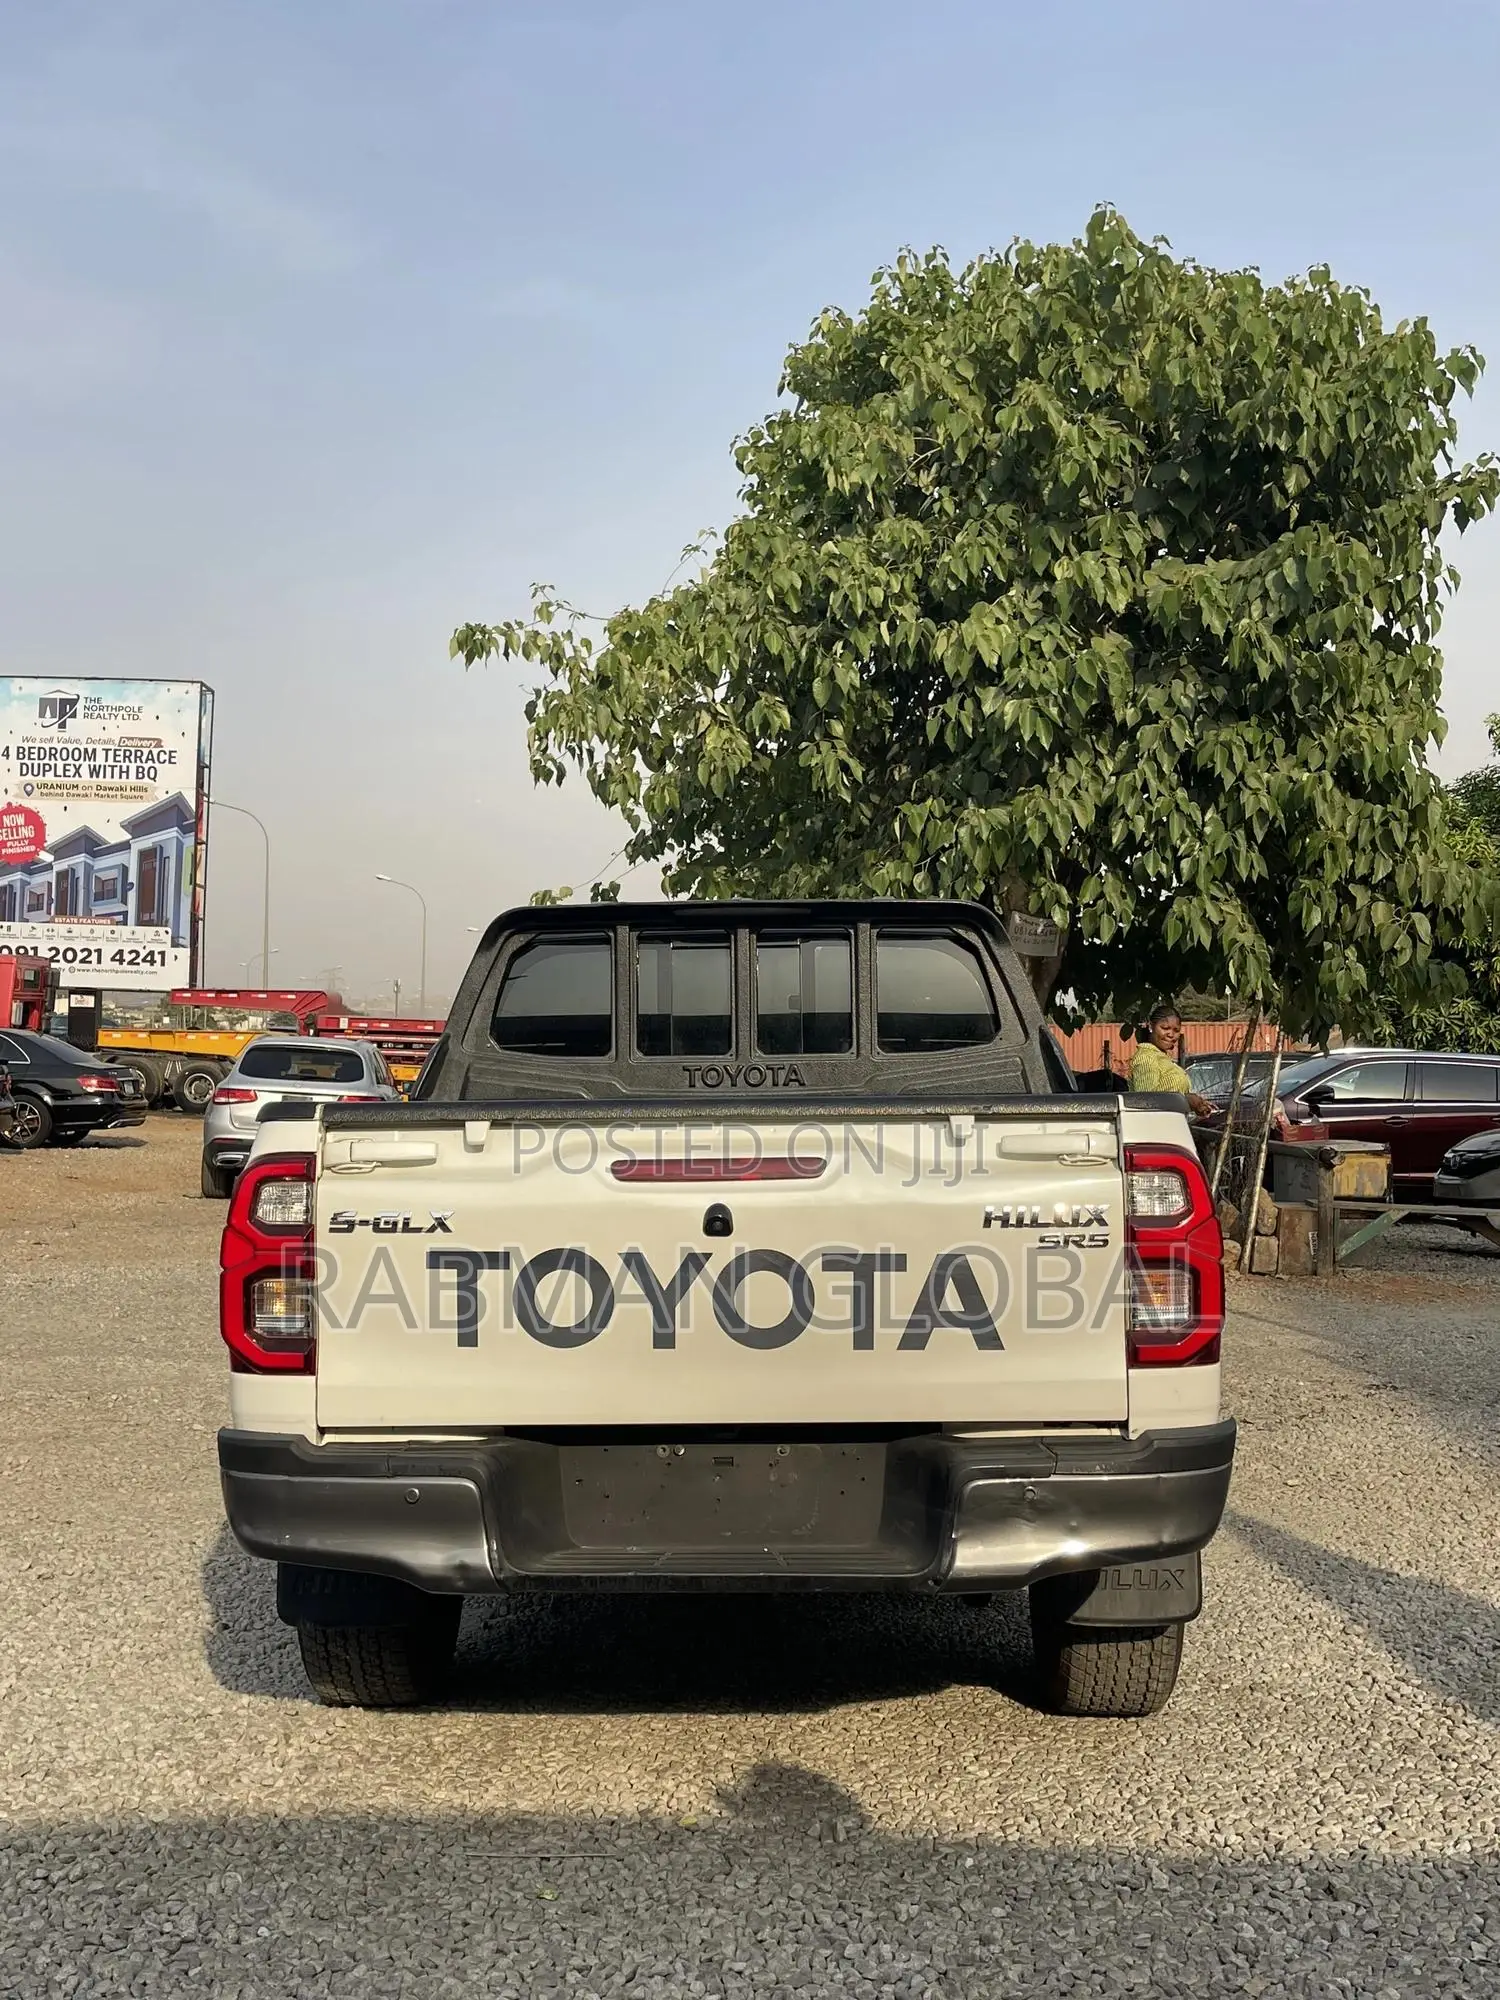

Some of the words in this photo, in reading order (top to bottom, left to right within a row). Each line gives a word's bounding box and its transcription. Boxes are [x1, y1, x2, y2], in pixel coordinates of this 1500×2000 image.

[83, 696, 103, 704] THE
[83, 704, 144, 713] NORTHPOLE
[83, 712, 119, 720] REALTY
[121, 713, 142, 721] LTD.
[21, 735, 38, 744] We
[38, 736, 54, 744] sell
[56, 736, 83, 746] Value,
[85, 737, 118, 747] Details,
[119, 738, 158, 748] Delivery
[1, 745, 10, 760] 4
[16, 746, 97, 763] BEDROOM
[102, 748, 178, 765] TERRACE
[19, 762, 83, 778] DUPLEX
[87, 764, 130, 780] WITH
[135, 766, 158, 783] BQ
[36, 782, 79, 791] URANIUM
[95, 784, 128, 793] Dawaki
[129, 785, 149, 794] Hills
[119, 793, 144, 801] Square
[2, 813, 25, 828] NOW
[1, 845, 36, 855] FINISHED
[6, 839, 30, 848] FULLY
[47, 946, 103, 965] 2021
[110, 948, 166, 967] 4241
[682, 1063, 807, 1089] TOYOTA
[327, 1209, 456, 1235] S-GLX
[981, 1202, 1111, 1230] HILUX
[1035, 1232, 1111, 1250] SR5
[425, 1247, 1006, 1351] TOYOTA
[1098, 1568, 1186, 1592] ILUX
